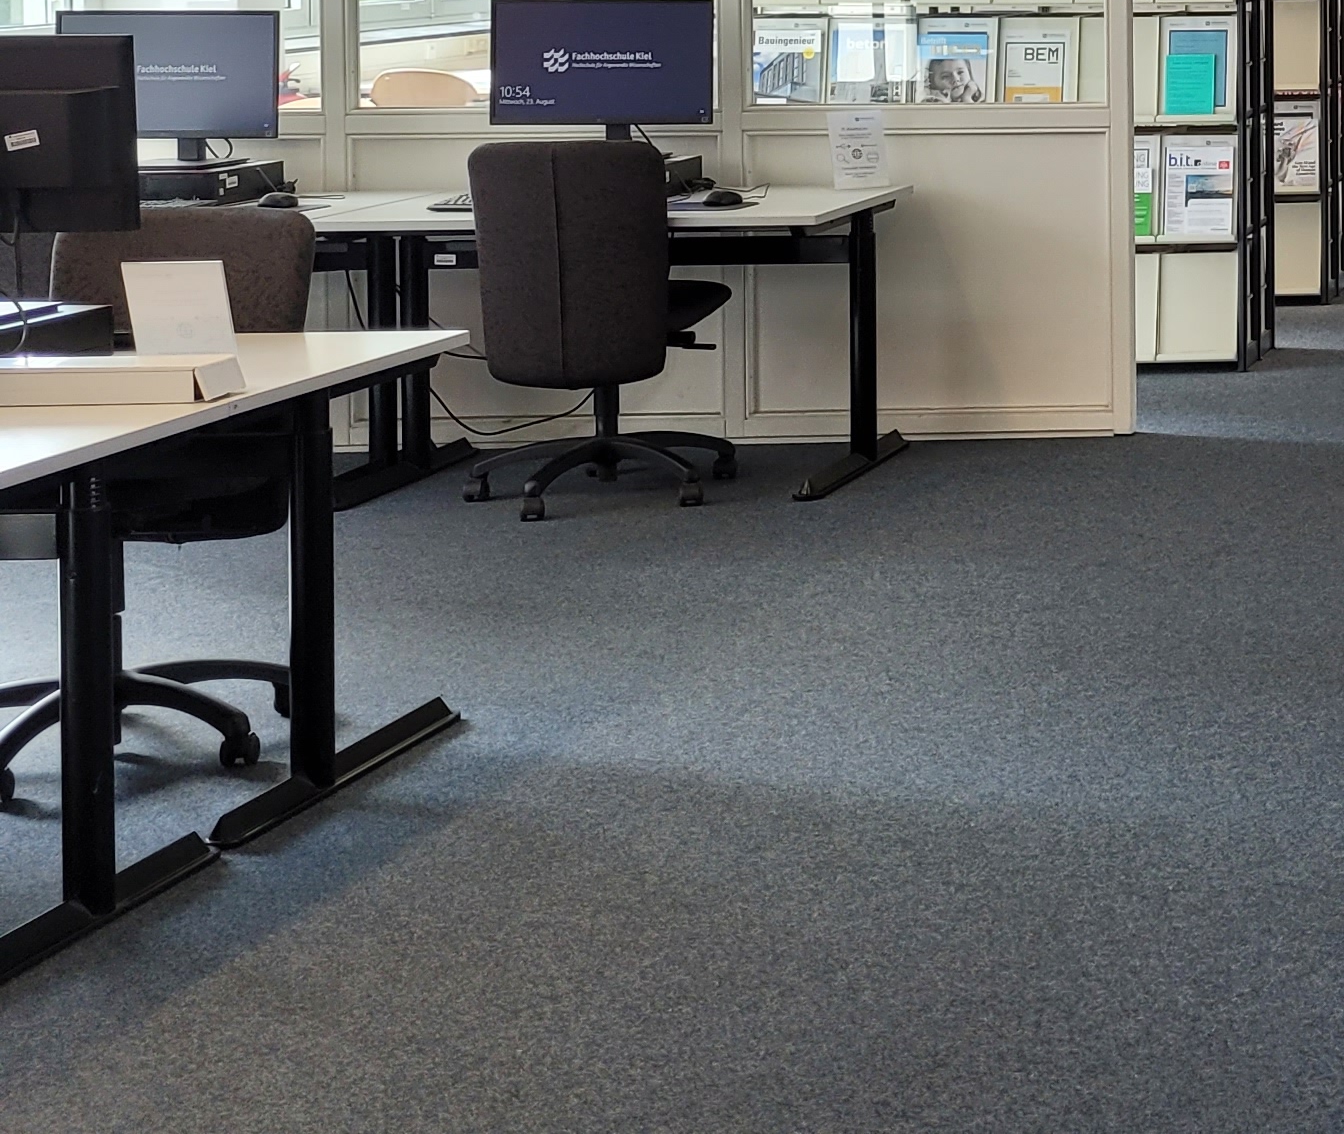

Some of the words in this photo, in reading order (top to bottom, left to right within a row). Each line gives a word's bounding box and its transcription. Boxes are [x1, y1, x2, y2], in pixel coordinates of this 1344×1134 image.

[758, 36, 815, 48] Bauingenieur
[571, 52, 635, 61] Fachhochschule
[636, 52, 652, 61] Kiel
[1024, 47, 1059, 62] BEM
[200, 65, 217, 73] Kiel
[500, 86, 530, 98] 10:54
